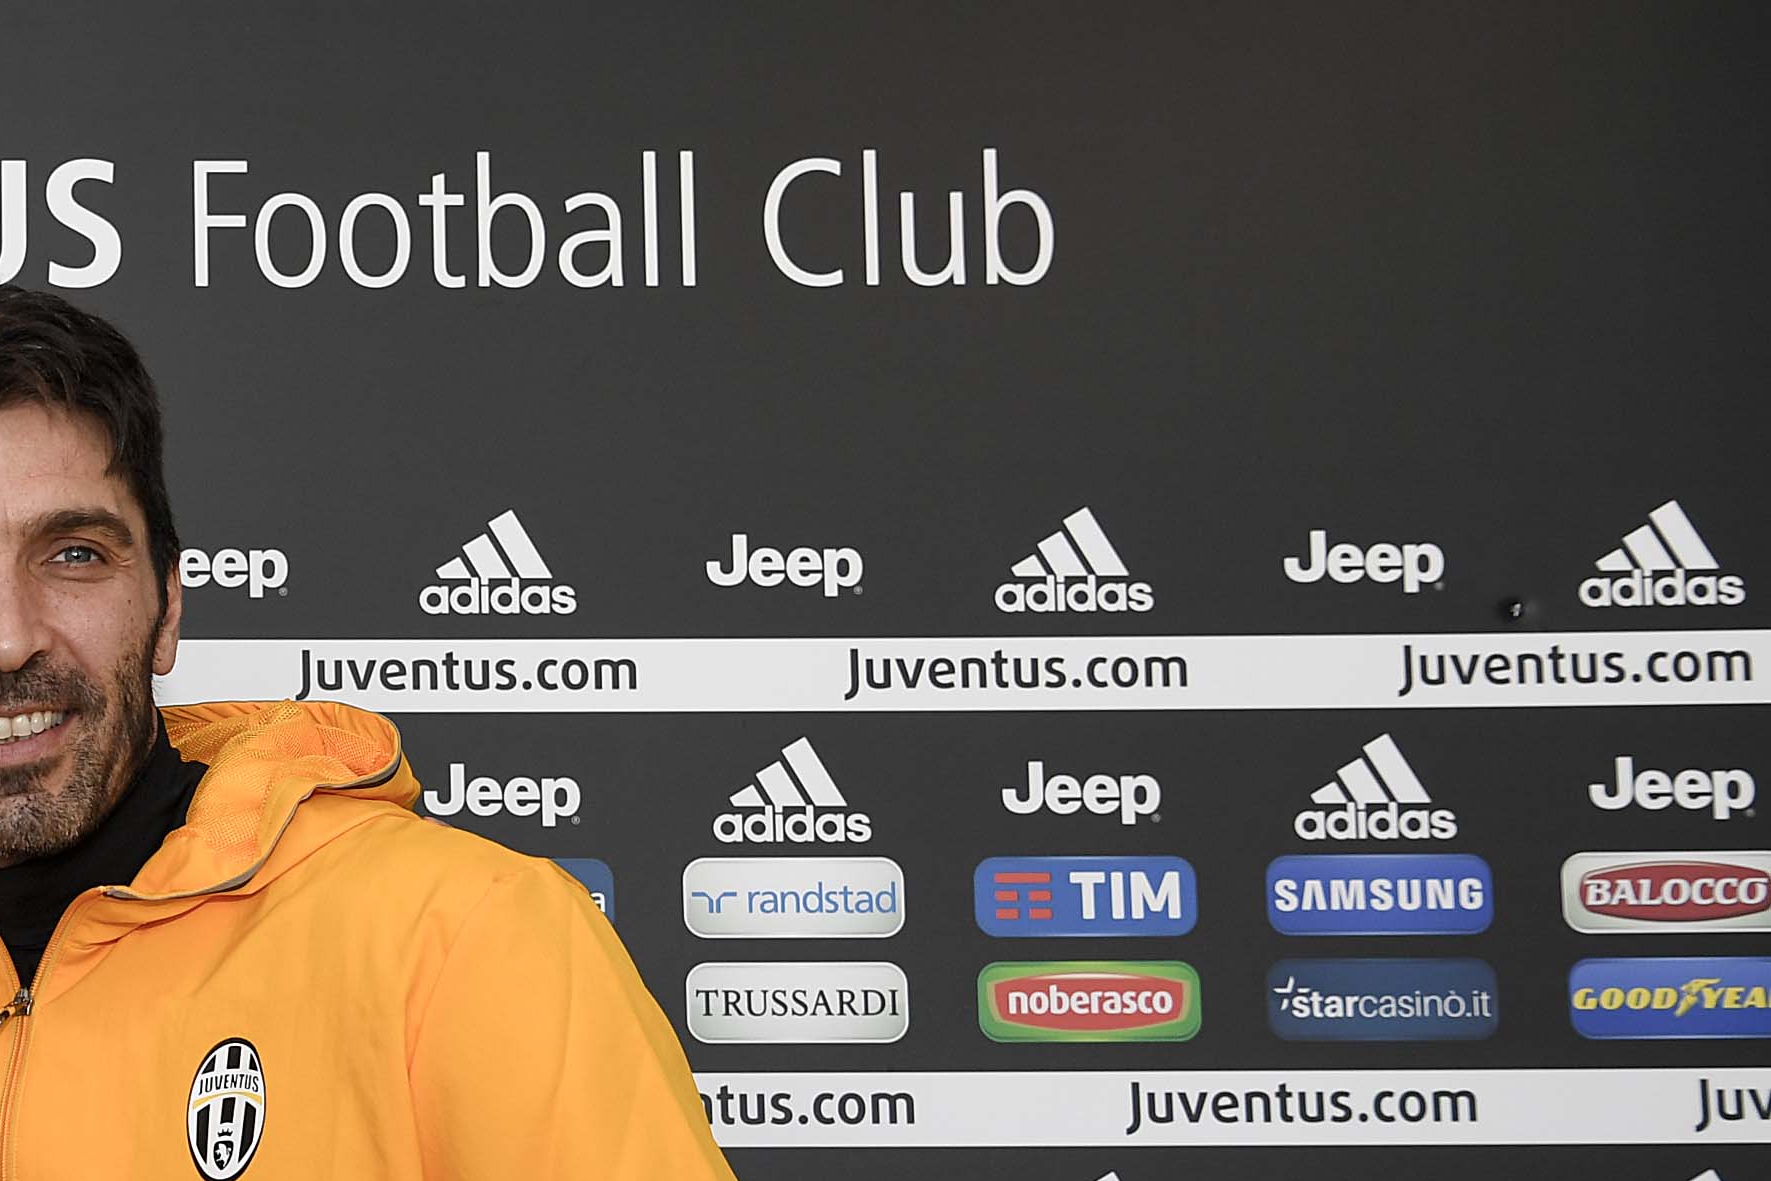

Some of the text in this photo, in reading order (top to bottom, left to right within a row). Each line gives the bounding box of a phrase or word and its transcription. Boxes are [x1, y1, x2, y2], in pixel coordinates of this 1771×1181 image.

[193, 149, 697, 289] Football
[763, 148, 1056, 289] Club
[178, 548, 289, 598] eep
[705, 533, 864, 597] Jeep
[1283, 529, 1445, 594] Jeep
[419, 578, 577, 615] adidas
[994, 575, 1155, 613] adidas
[1578, 567, 1746, 608] adidas
[296, 649, 637, 701] Juventus.com
[844, 647, 1189, 701] Juventus.com
[1399, 643, 1753, 696] Juventus.com
[423, 763, 581, 827] Jeep
[1001, 760, 1161, 825] Jeep
[1588, 756, 1755, 820] Jeep
[713, 804, 872, 843] adidas
[1293, 801, 1458, 841] adidas
[746, 881, 897, 915] randstad
[1068, 870, 1182, 921] TIM
[1273, 876, 1485, 912] SAMSUNG
[1583, 877, 1769, 906] BALOCCO
[695, 988, 900, 1018] TRUSSARDI
[1007, 985, 1174, 1016] noberasco
[1290, 987, 1492, 1020] starcasinò.it
[1572, 986, 1771, 1012] GOODYEA
[198, 1073, 260, 1096] JUVENTUS
[1125, 1081, 1479, 1136] Juventus.com
